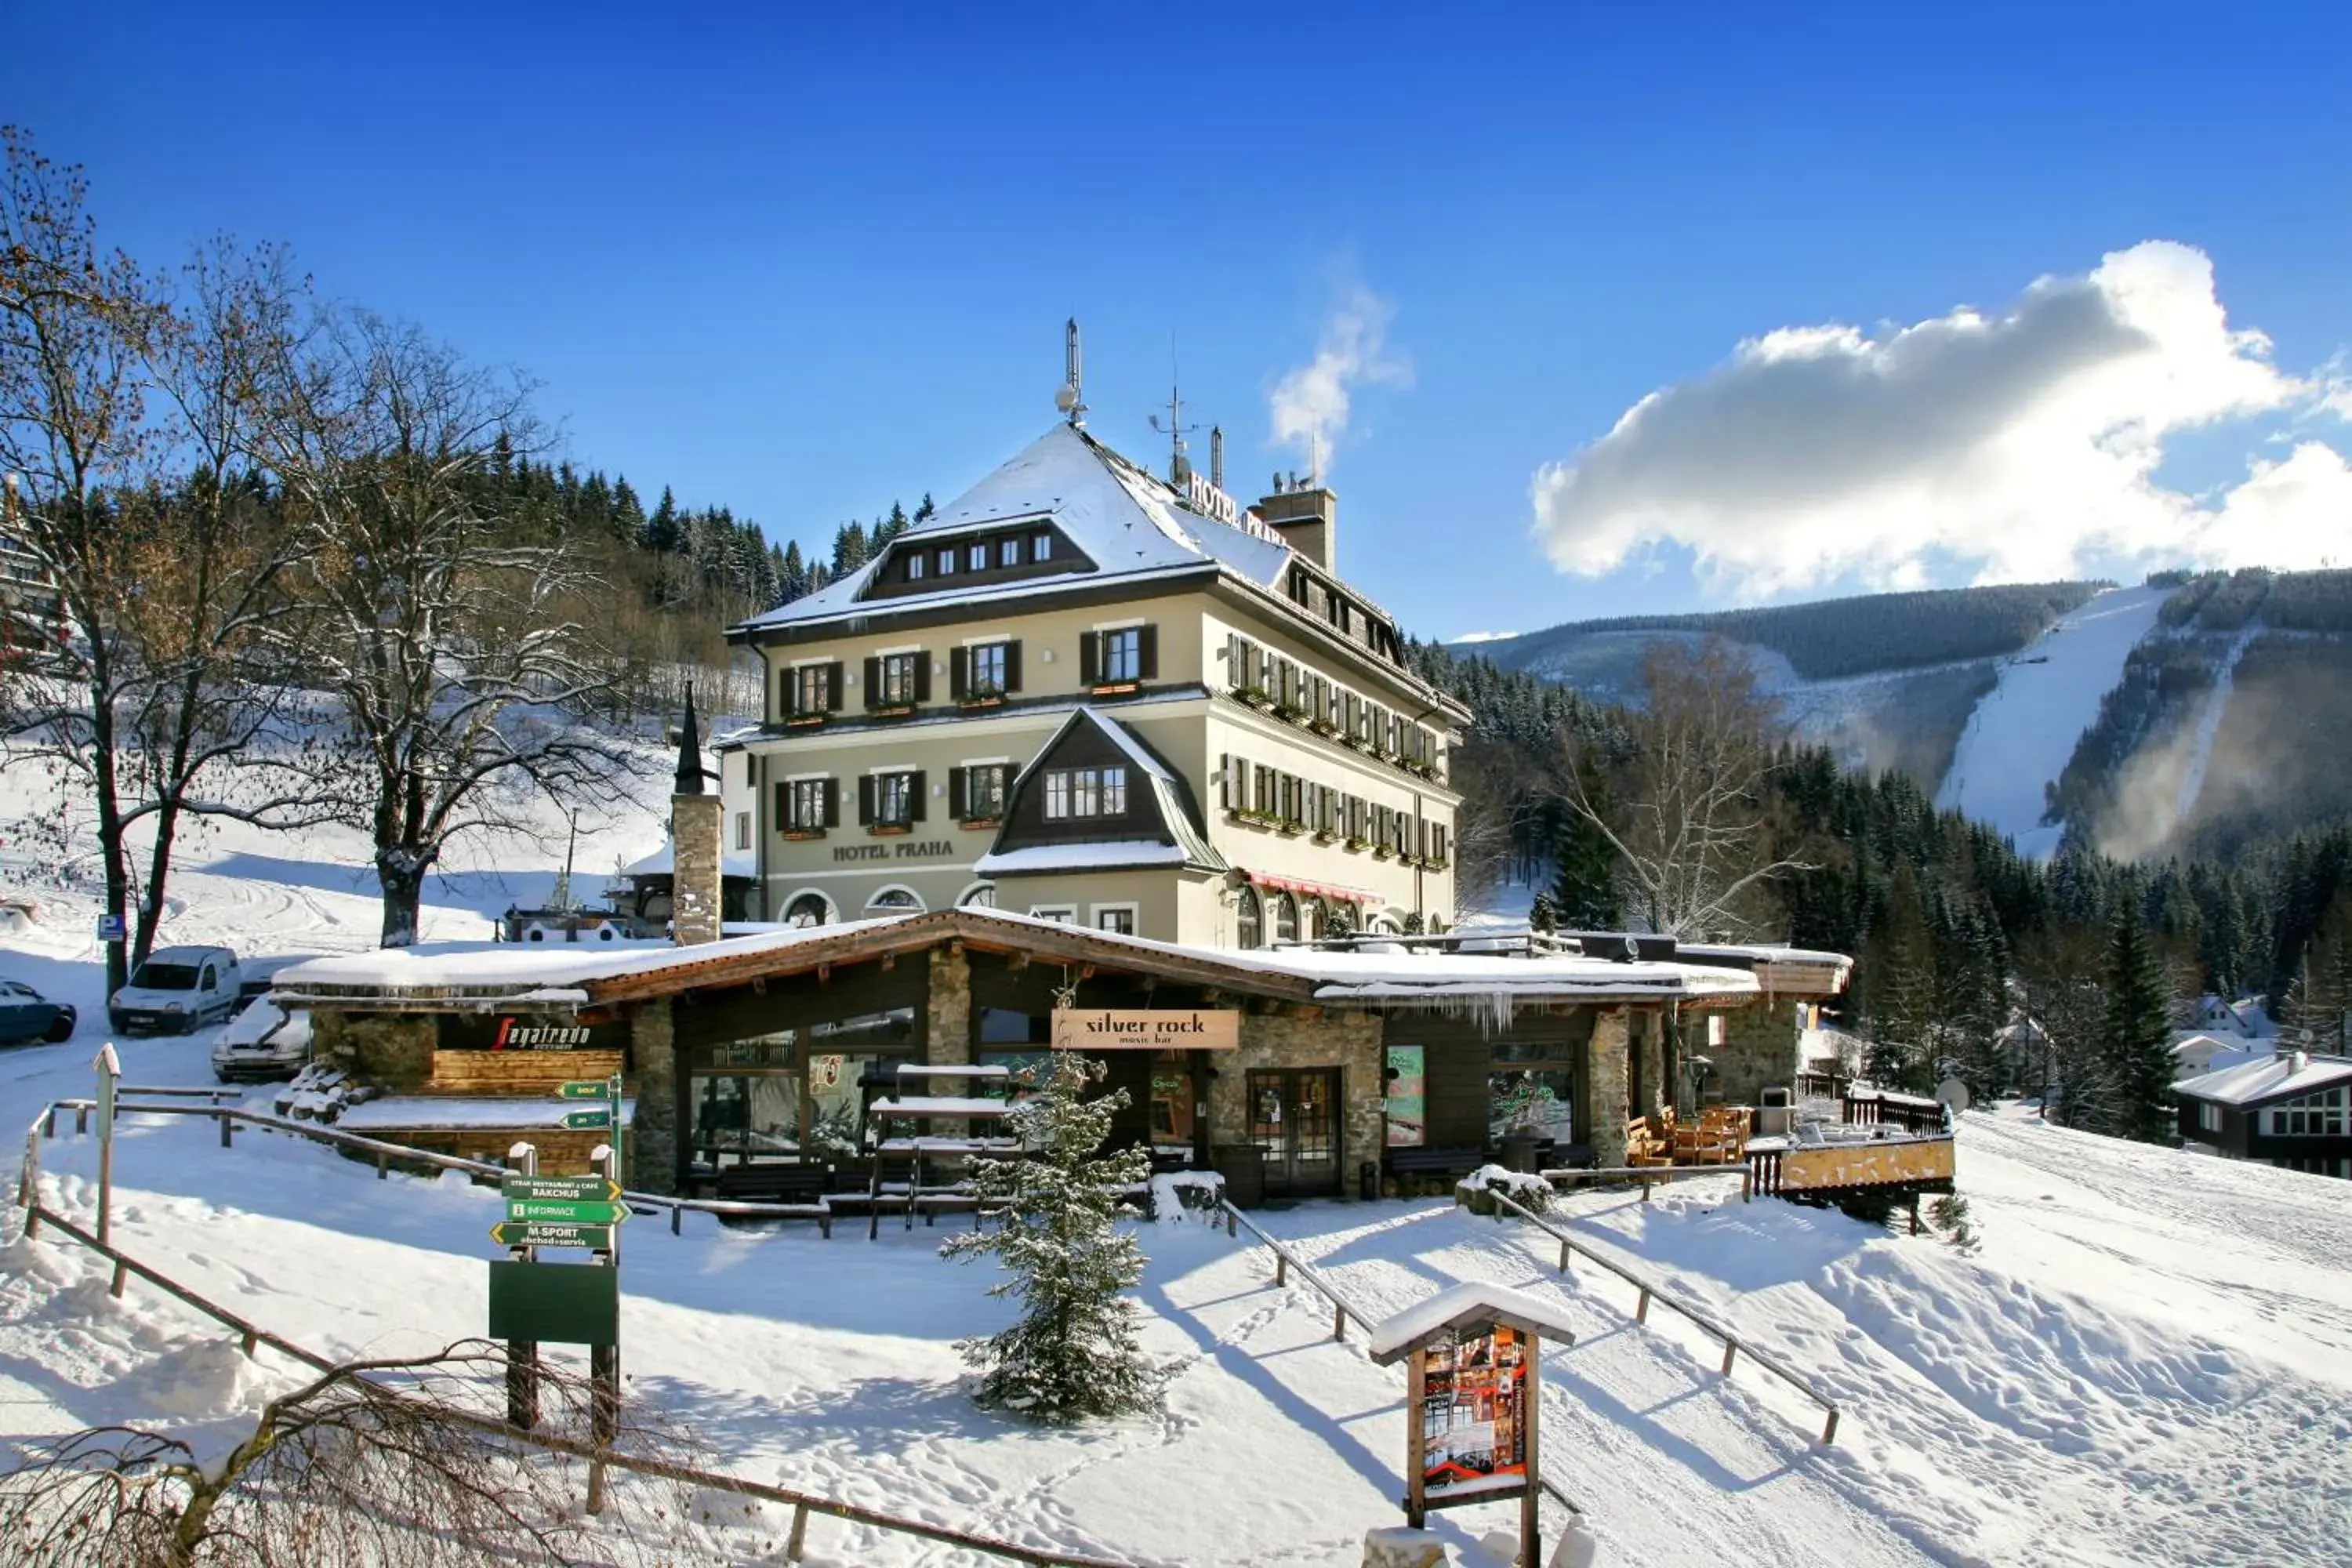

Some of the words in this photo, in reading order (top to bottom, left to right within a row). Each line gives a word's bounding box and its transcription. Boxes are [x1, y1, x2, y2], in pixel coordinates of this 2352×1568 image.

[1191, 471, 1241, 529] HOTEL
[833, 844, 890, 862] HOTEL
[895, 840, 953, 858] PRAHA
[100, 916, 118, 932] P
[1087, 1013, 1148, 1033] silver
[1156, 1013, 1204, 1033] rock
[1155, 1034, 1172, 1044] bar
[532, 1188, 580, 1198] BAKCHUS
[528, 1207, 575, 1216] INFORMACE
